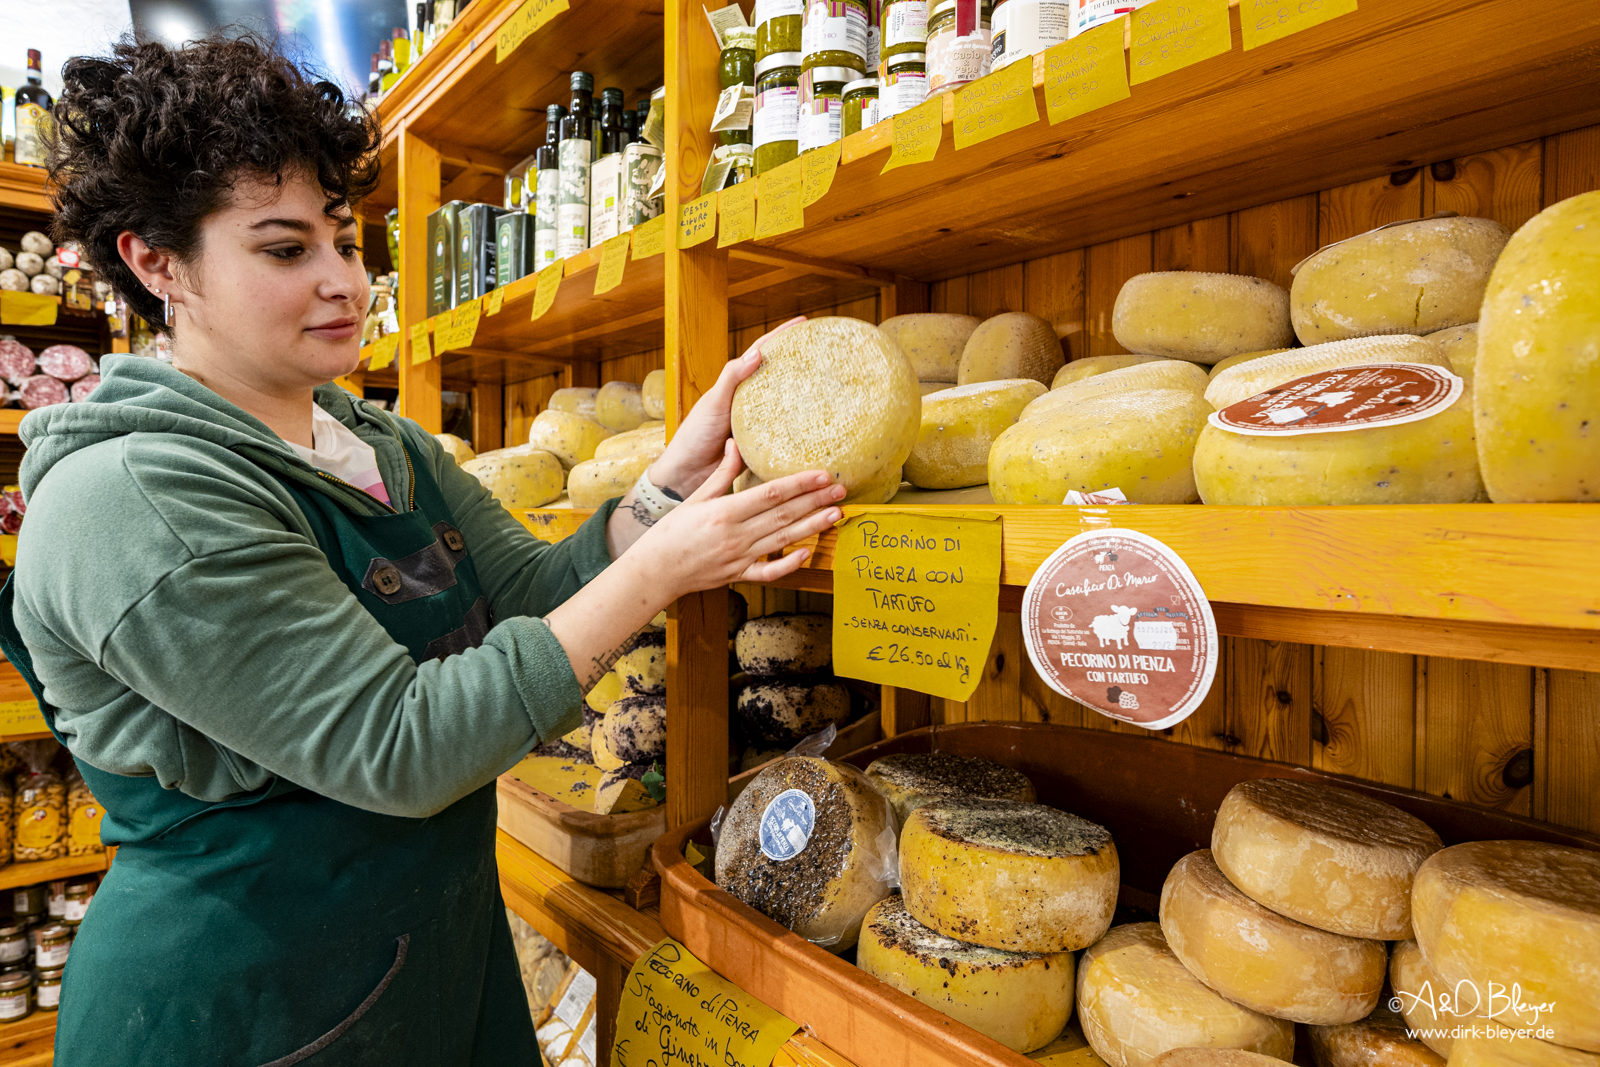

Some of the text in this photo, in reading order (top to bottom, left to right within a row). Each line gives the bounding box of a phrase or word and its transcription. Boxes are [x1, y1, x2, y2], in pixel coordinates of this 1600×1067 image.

[953, 51, 980, 59] Cacio
[955, 66, 978, 74] Pepe
[684, 201, 709, 216] PESTO
[858, 520, 961, 551] PECORINO DI
[851, 556, 964, 584] PIENZA CON
[1056, 572, 1158, 597] Caseificio Di Mario
[866, 588, 935, 612] TARTUFO
[937, 652, 952, 668] al
[955, 655, 969, 684] Kg
[1060, 652, 1176, 672] PECORINO DI PIENZA
[1087, 671, 1148, 684] CON TARTUFO
[644, 943, 700, 998] PECORINO
[715, 998, 760, 1044] PIENZA
[635, 1011, 650, 1034] di
[705, 1031, 718, 1055] in
